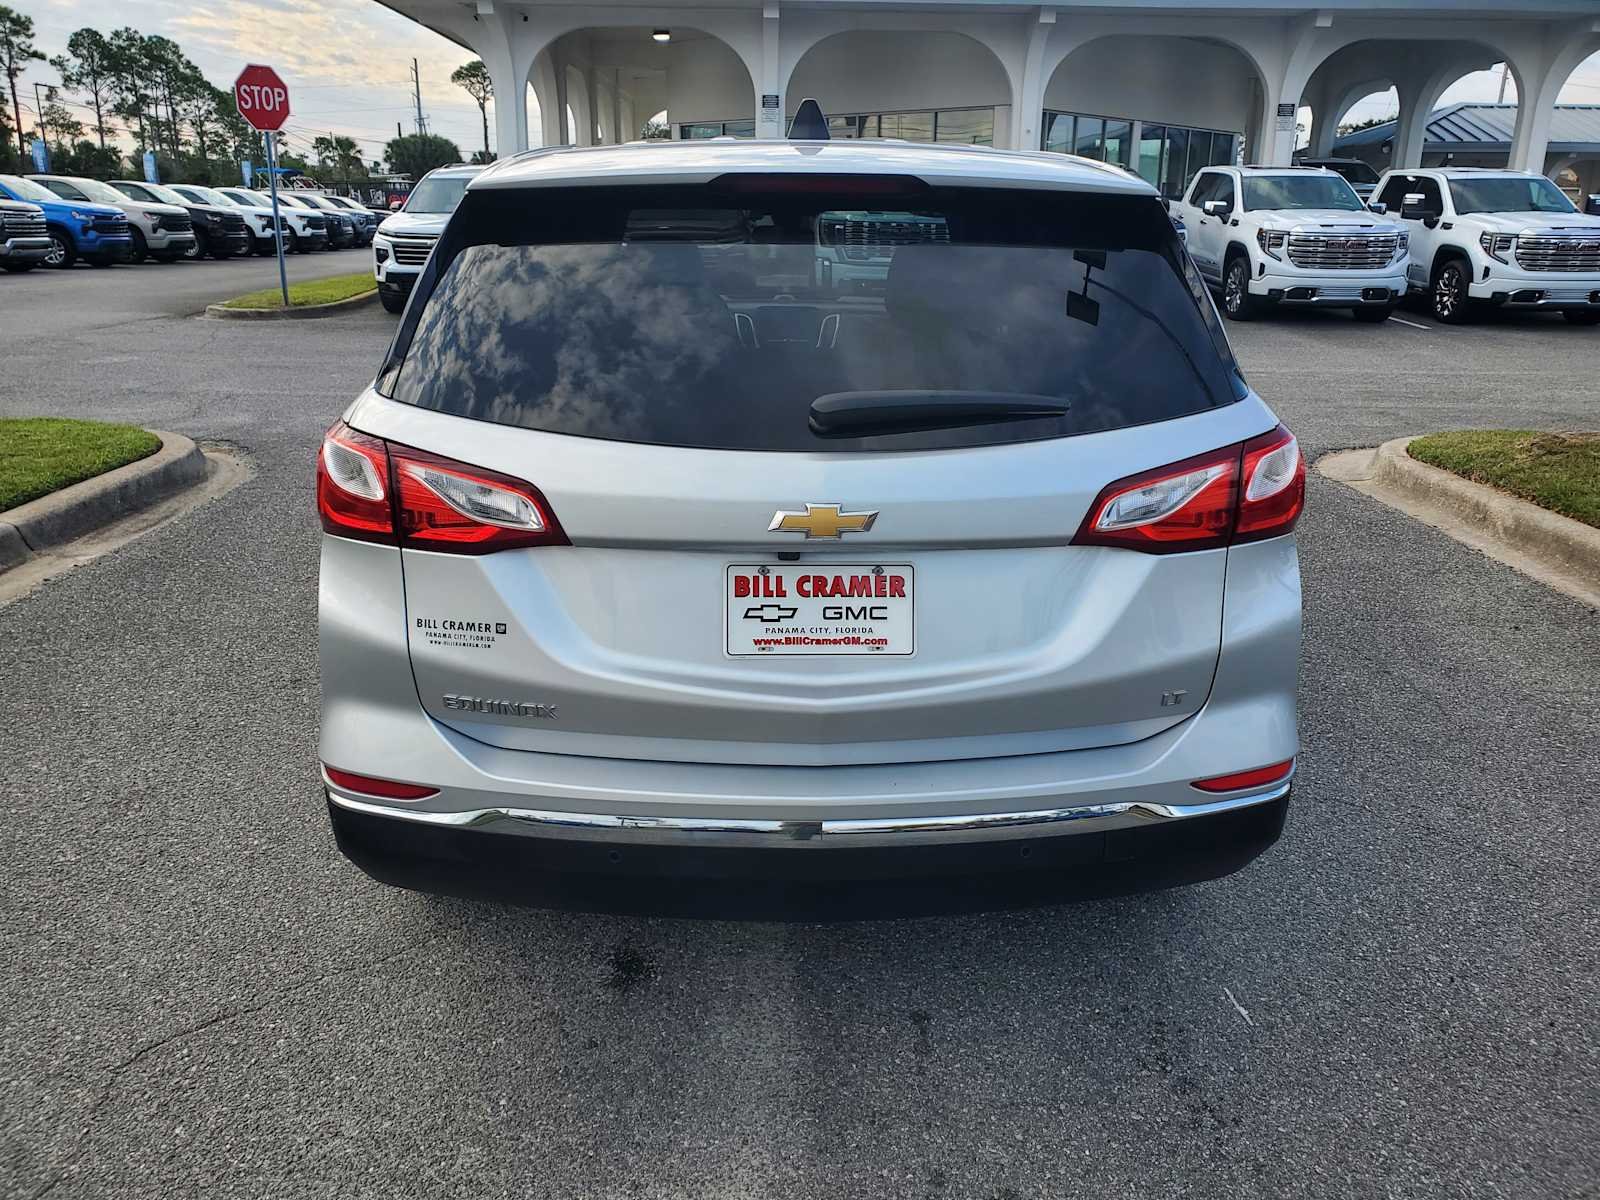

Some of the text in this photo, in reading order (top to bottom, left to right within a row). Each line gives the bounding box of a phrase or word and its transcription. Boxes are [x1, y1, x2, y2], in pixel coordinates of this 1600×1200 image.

[240, 84, 285, 111] STOP
[734, 575, 906, 598] BILL CRAMER
[823, 606, 888, 620] GMC
[416, 618, 492, 633] BILL CRAMER
[809, 627, 831, 635] CITY,
[753, 637, 888, 646] www.BillCramerGM.com
[442, 694, 559, 720] EQUINOX
